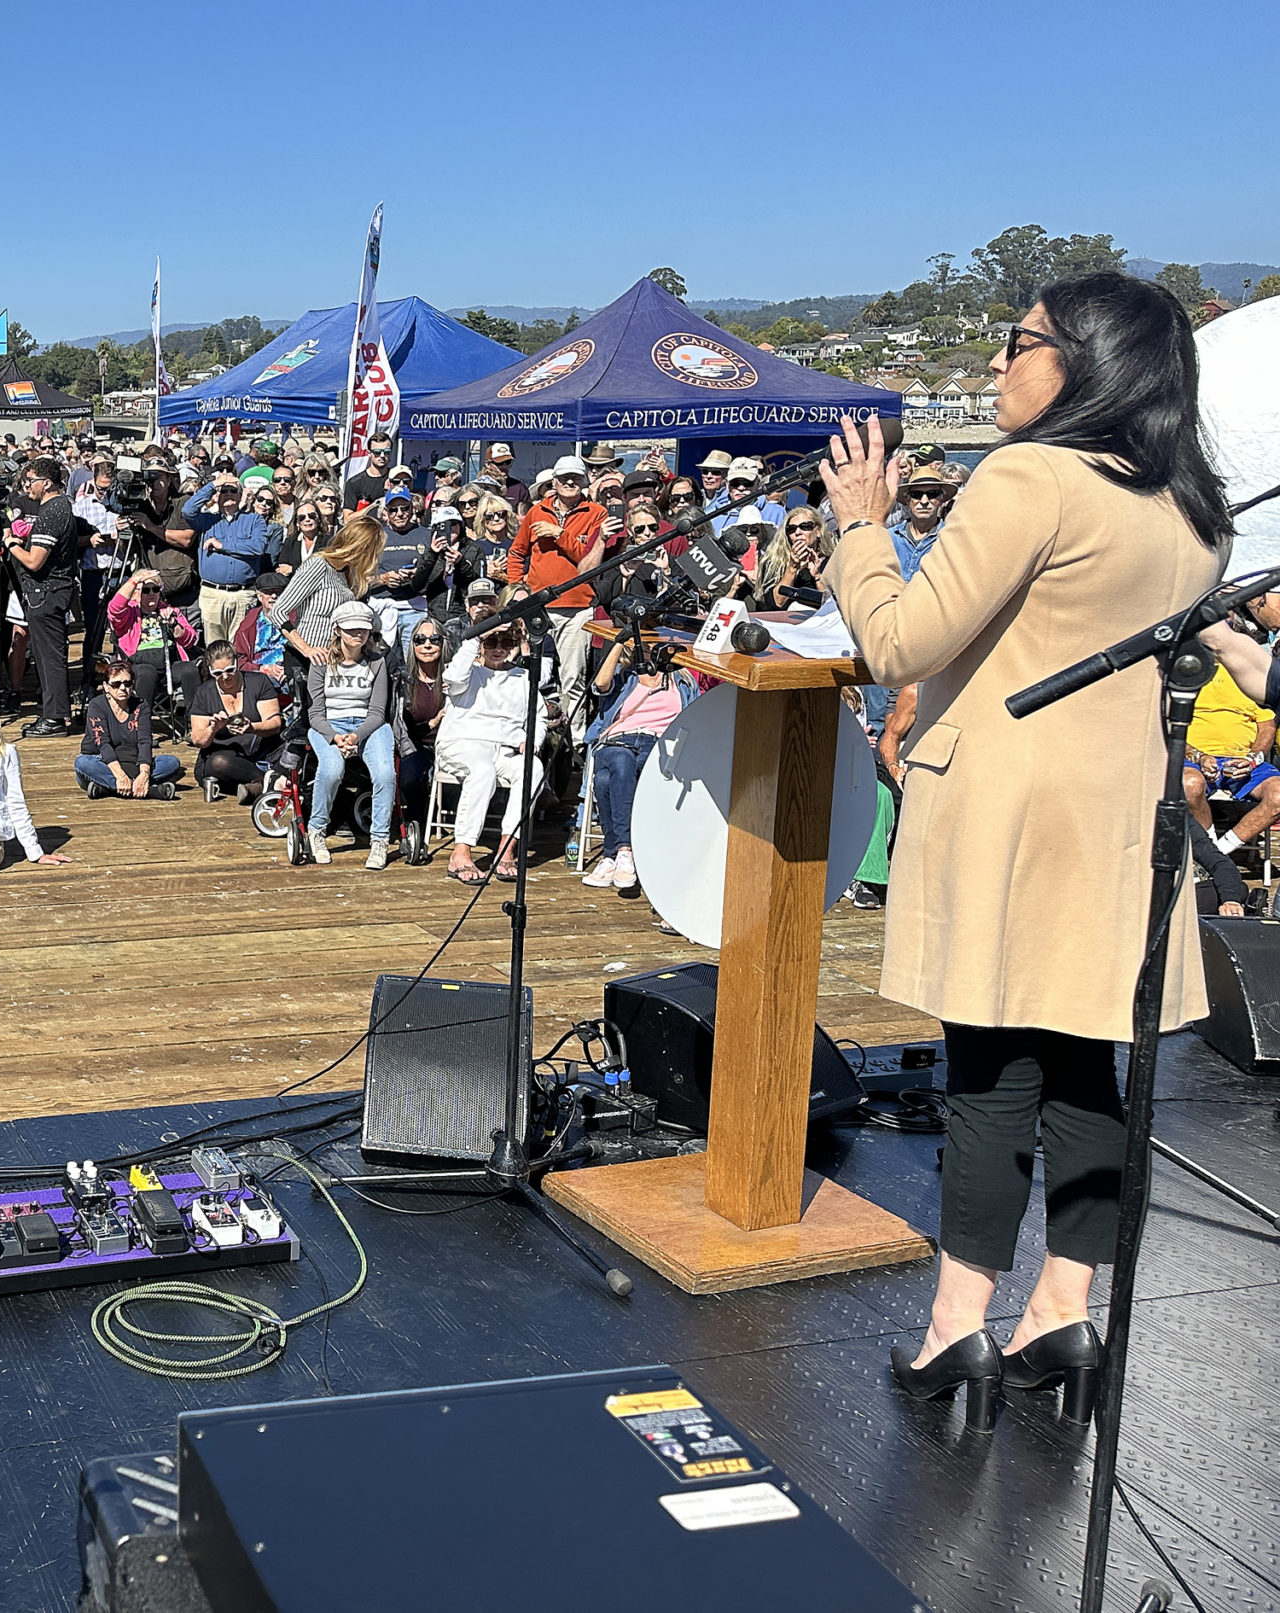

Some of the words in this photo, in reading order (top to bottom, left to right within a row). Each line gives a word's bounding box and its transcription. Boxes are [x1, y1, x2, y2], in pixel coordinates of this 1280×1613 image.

[662, 338, 679, 350] OF
[681, 336, 746, 368] CAPITOLA
[657, 349, 674, 371] CITY
[369, 341, 394, 423] CLUB
[195, 397, 220, 415] Capitola
[220, 394, 241, 411] Junior
[242, 395, 273, 413] Guards
[410, 413, 457, 430] CAPITOLA
[458, 412, 517, 430] LIFEGUARD
[517, 412, 564, 430] SERVICE
[605, 408, 699, 429] CAPITOLA
[703, 405, 806, 426] LIFEGUARD
[807, 406, 880, 424] SERVICE
[688, 545, 718, 576] KTVU
[706, 623, 721, 642] 48
